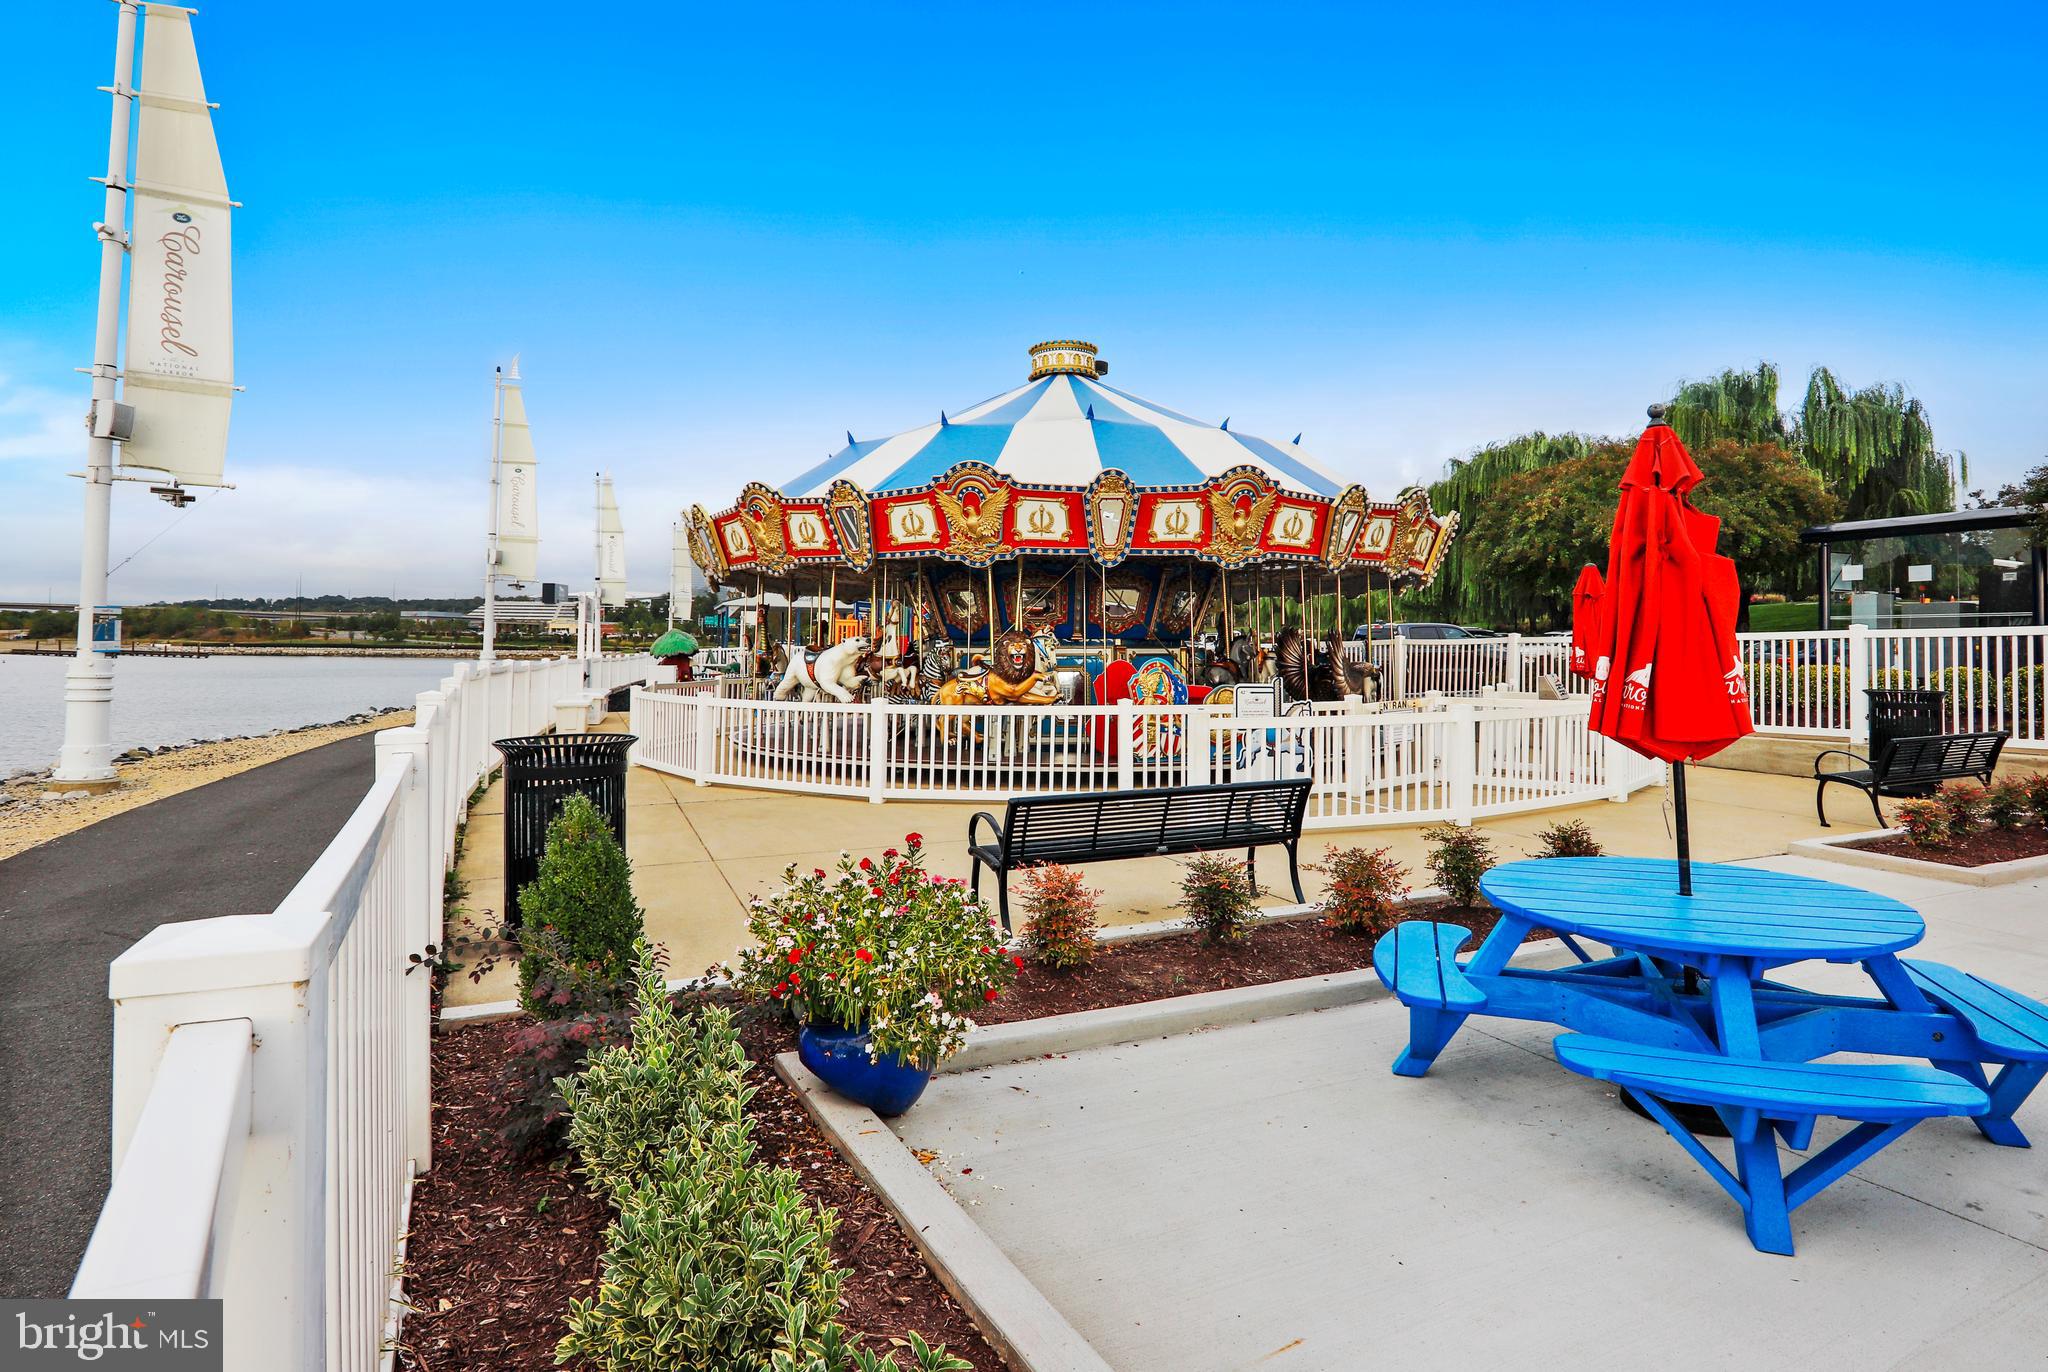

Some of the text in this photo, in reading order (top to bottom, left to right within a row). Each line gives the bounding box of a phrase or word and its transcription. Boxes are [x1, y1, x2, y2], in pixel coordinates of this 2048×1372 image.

[157, 226, 200, 357] Carousel
[150, 361, 199, 372] NATIONAL
[155, 368, 193, 377] HARBOR
